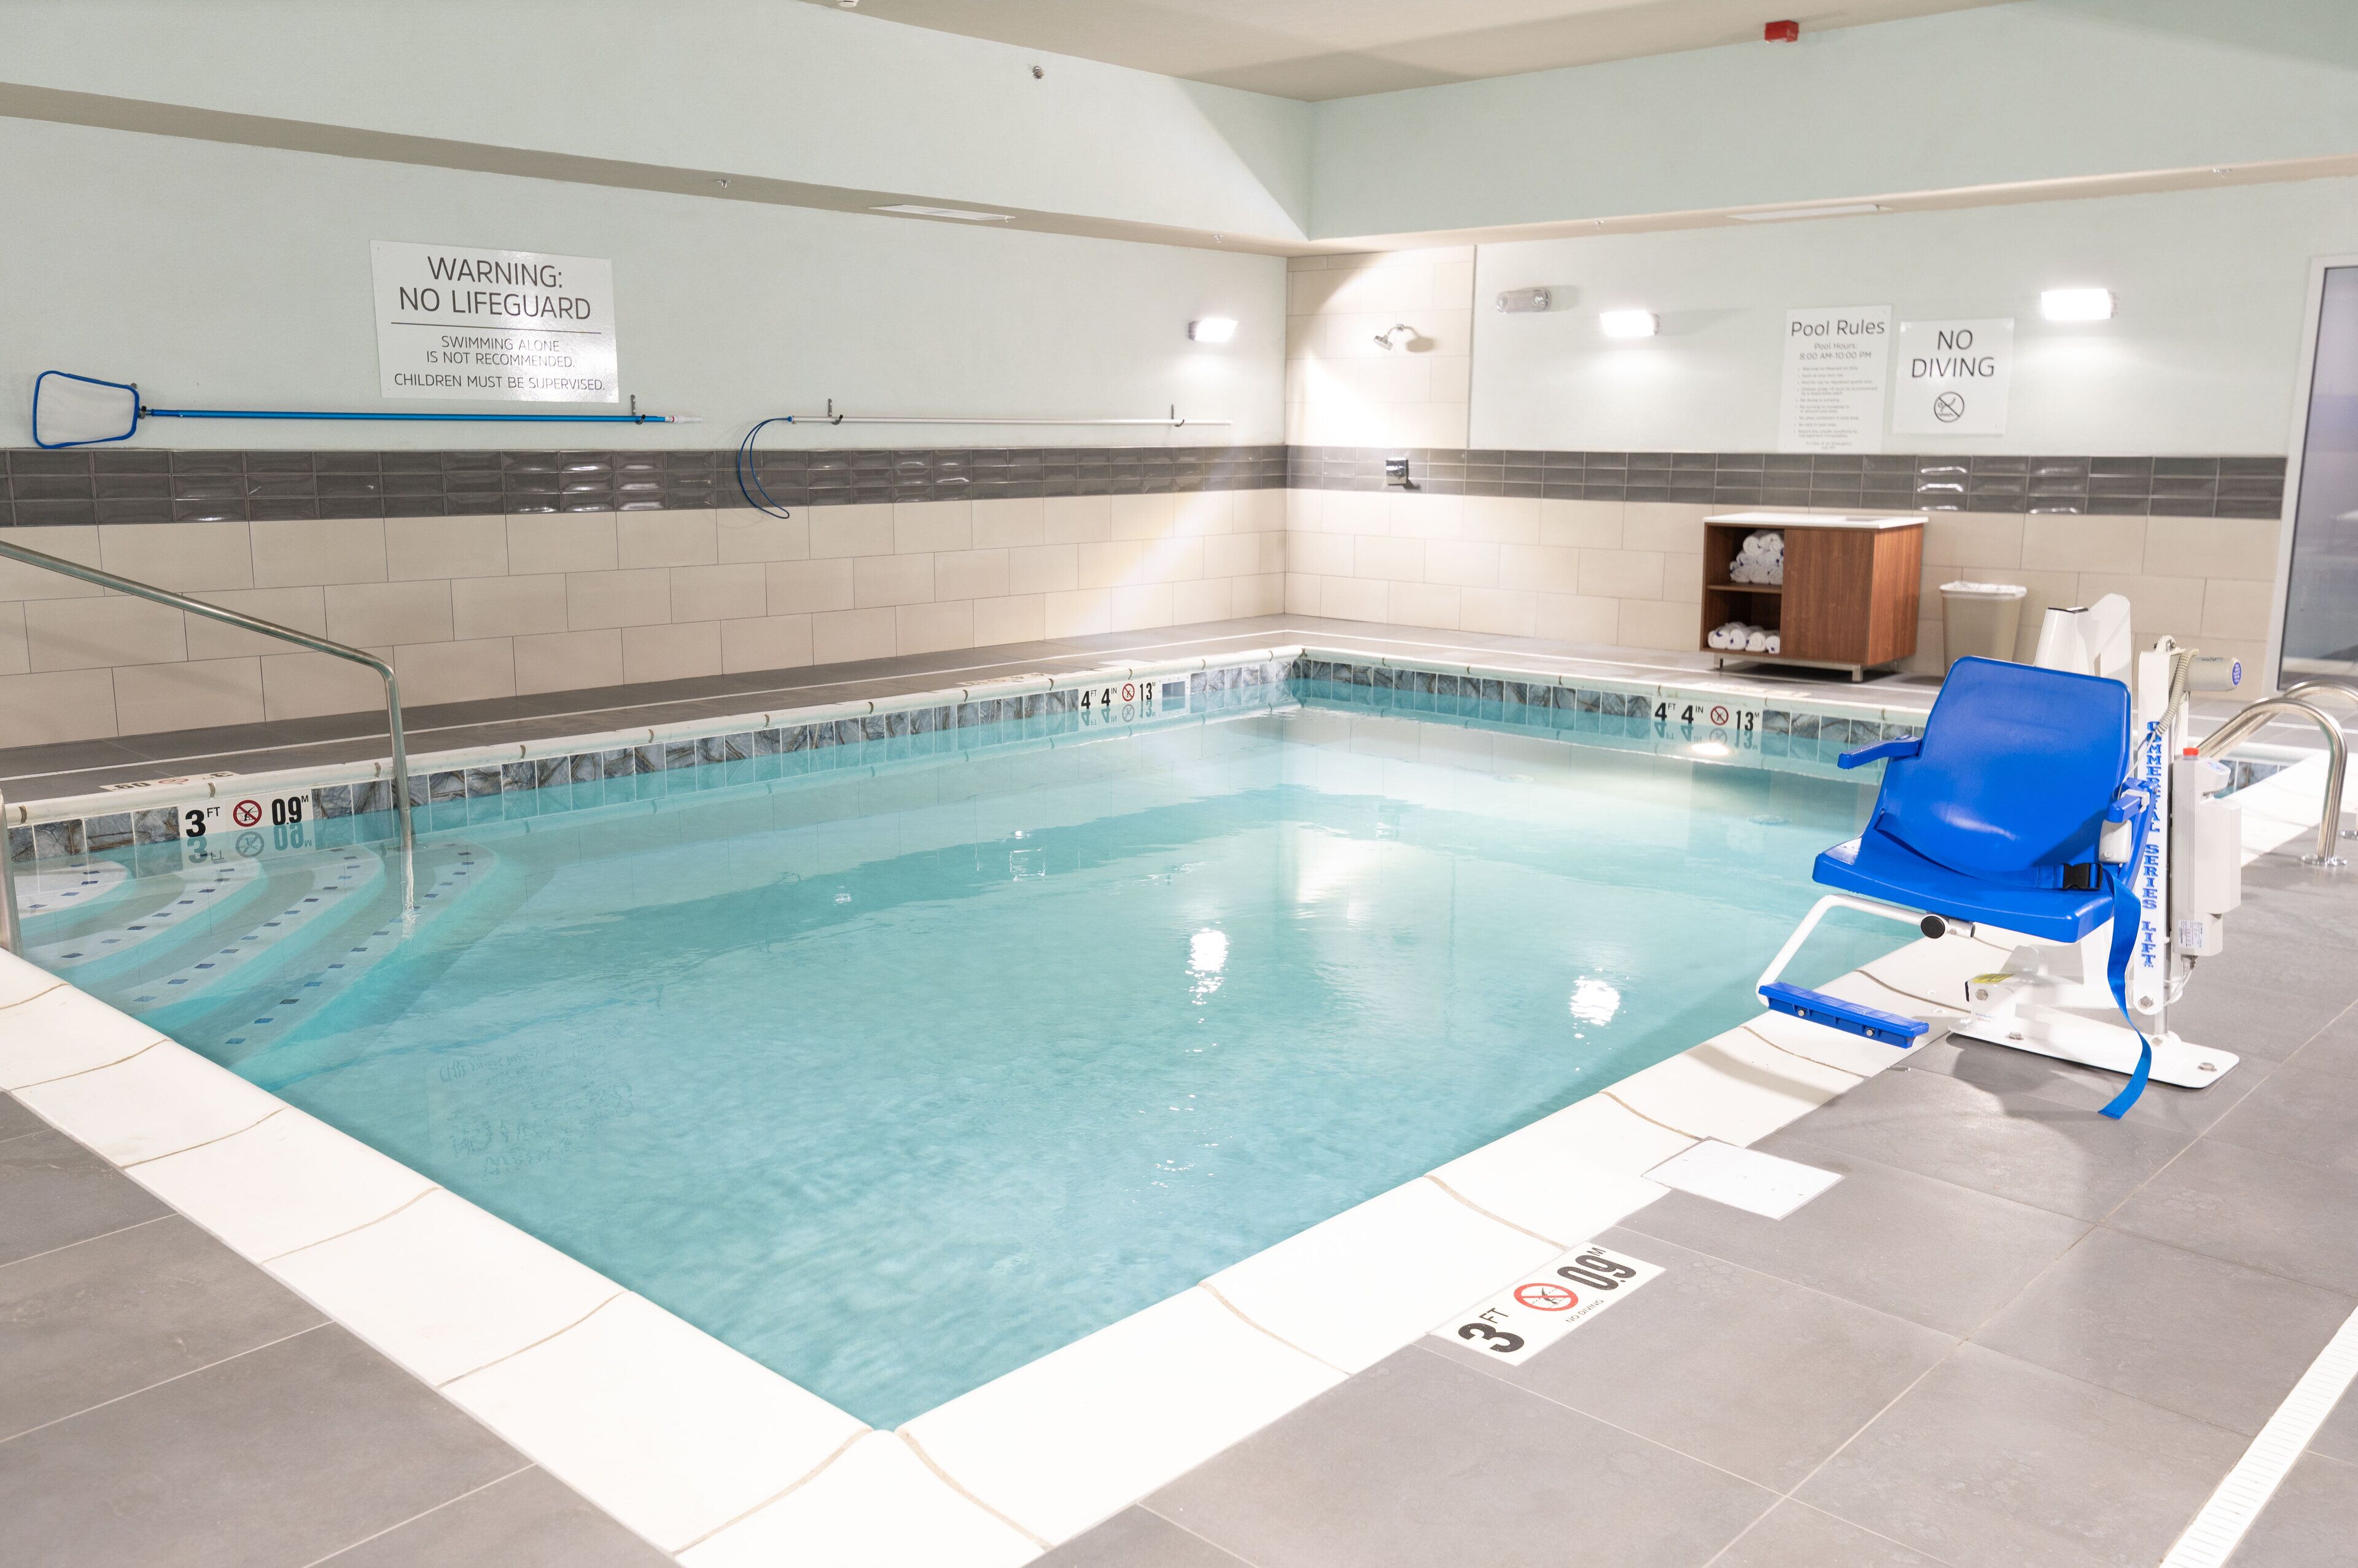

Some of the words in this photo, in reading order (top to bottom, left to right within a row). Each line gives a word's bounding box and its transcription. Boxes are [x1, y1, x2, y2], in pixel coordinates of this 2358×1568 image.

[427, 256, 562, 289] WARNING:
[400, 286, 440, 312] NO
[452, 290, 591, 320] LIFEGUARD
[1791, 320, 1829, 336] Pool
[1837, 319, 1885, 335] Rules
[442, 336, 513, 351] SWIMMING
[518, 339, 559, 352] ALONE
[1937, 329, 1973, 350] NO
[427, 351, 438, 363] IS
[443, 352, 470, 364] NOT
[476, 353, 575, 368] RECOMMENDED.
[1912, 357, 1994, 378] DIVING
[394, 373, 462, 387] CHILDREN
[467, 375, 502, 389] MUST
[508, 376, 524, 389] BE
[529, 377, 605, 392] SUPERVISED.
[1081, 691, 1091, 710] 4
[1101, 688, 1111, 707] 4
[1654, 702, 1667, 721] 4
[1681, 705, 1694, 724] 4
[185, 809, 206, 838] 3
[207, 806, 220, 818] FT
[271, 796, 302, 826] 0.9
[2142, 844, 2159, 910] SERIES
[2141, 921, 2157, 966] LIFT
[1587, 1247, 1606, 1257] M
[1557, 1254, 1636, 1291] 0.9
[1479, 1307, 1509, 1324] FT
[1565, 1314, 1581, 1323] NO
[1579, 1298, 1605, 1316] DIVING
[1458, 1322, 1525, 1353] 3
